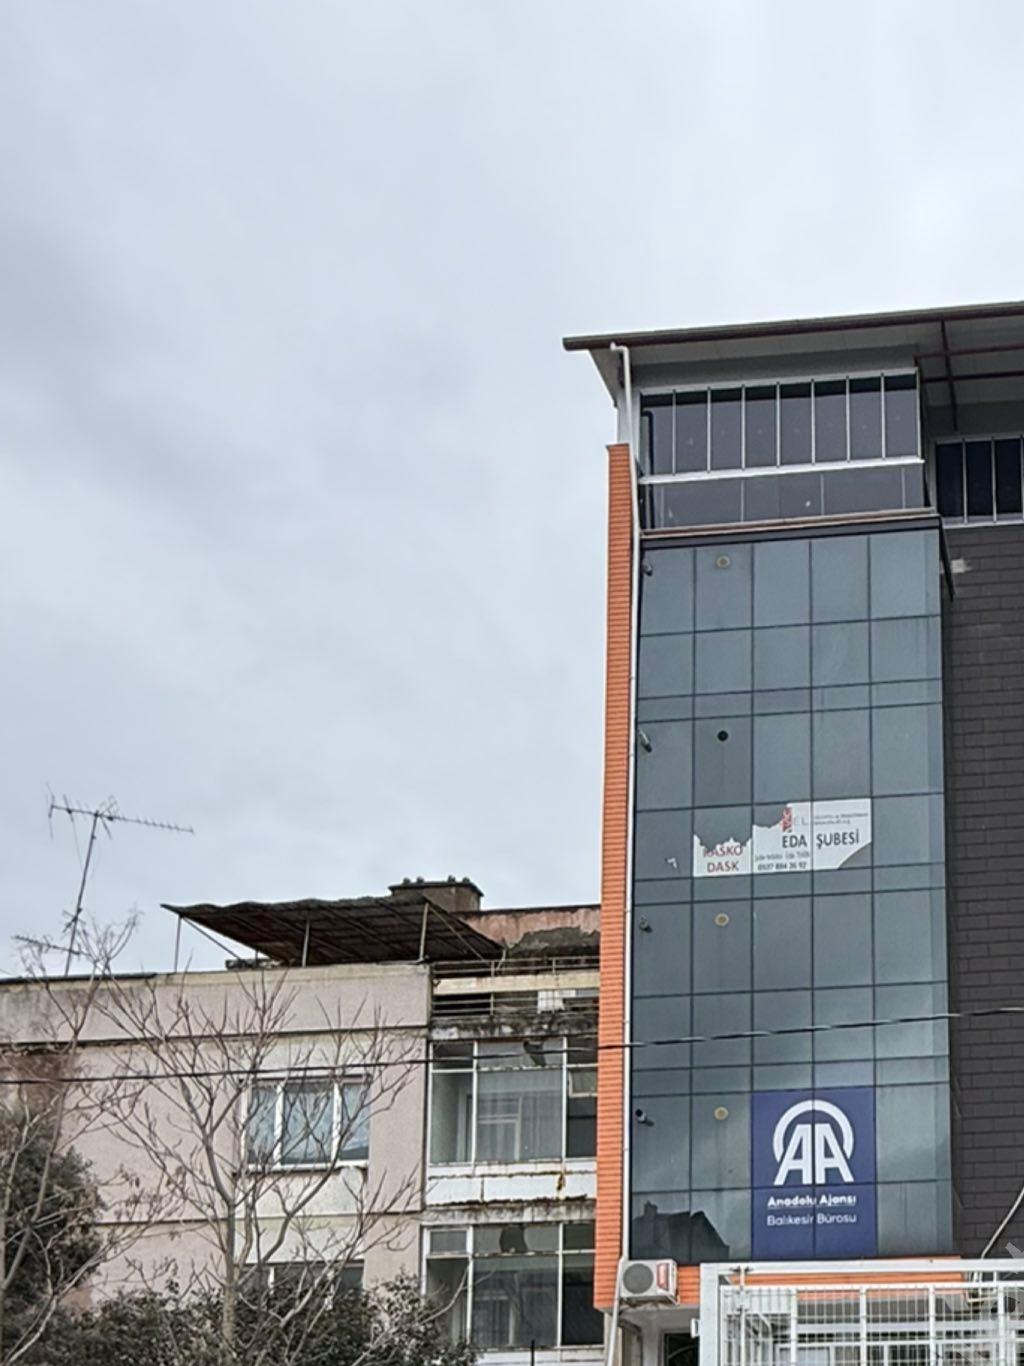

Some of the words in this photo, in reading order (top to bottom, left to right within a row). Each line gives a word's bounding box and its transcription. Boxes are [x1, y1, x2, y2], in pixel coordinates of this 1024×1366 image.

[782, 835, 807, 849] EDA
[816, 829, 860, 850] ŞUBESİ
[707, 860, 740, 873] DASK
[767, 1194, 817, 1207] Anadolu
[817, 1212, 857, 1224] Bürosu
